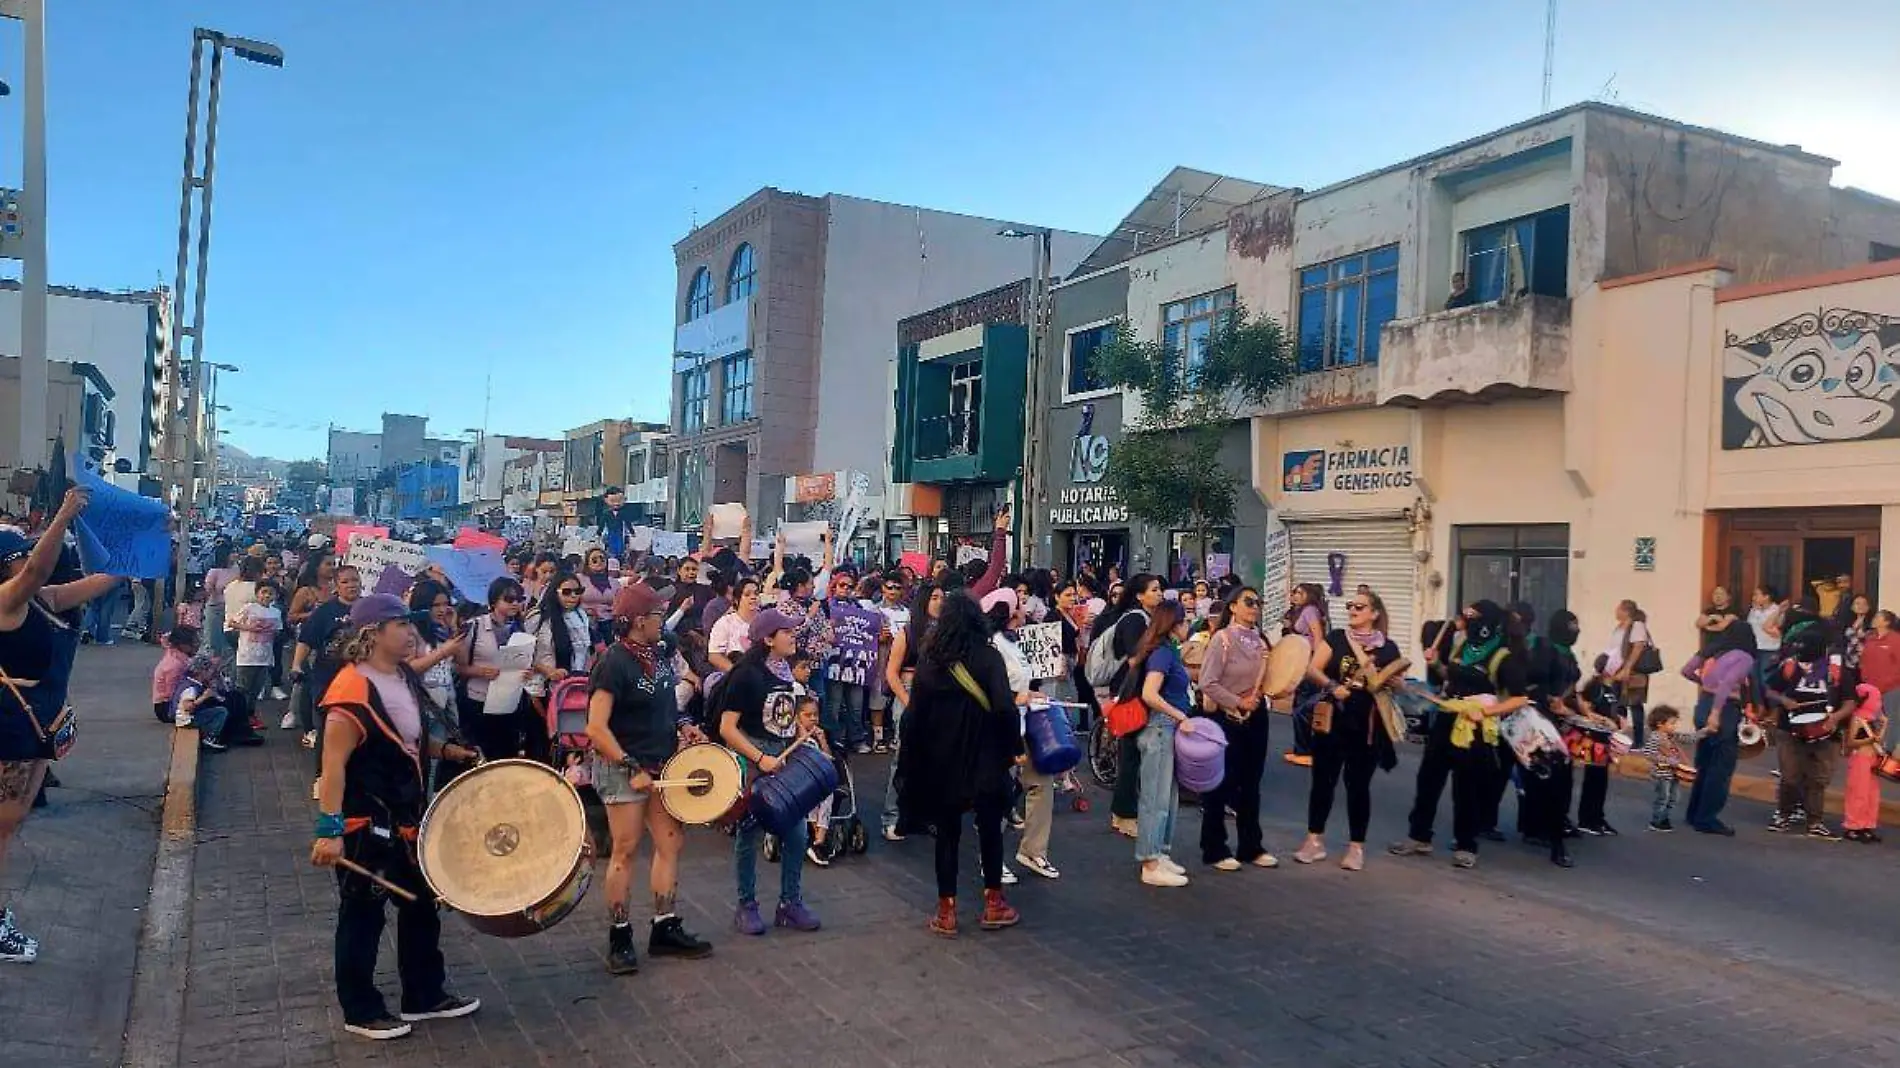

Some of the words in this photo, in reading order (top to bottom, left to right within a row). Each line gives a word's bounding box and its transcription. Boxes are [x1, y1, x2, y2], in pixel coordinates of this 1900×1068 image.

[1327, 446, 1409, 470] FARMACIA
[1334, 471, 1413, 490] GENERICOS
[1049, 507, 1102, 523] PUBLICA
